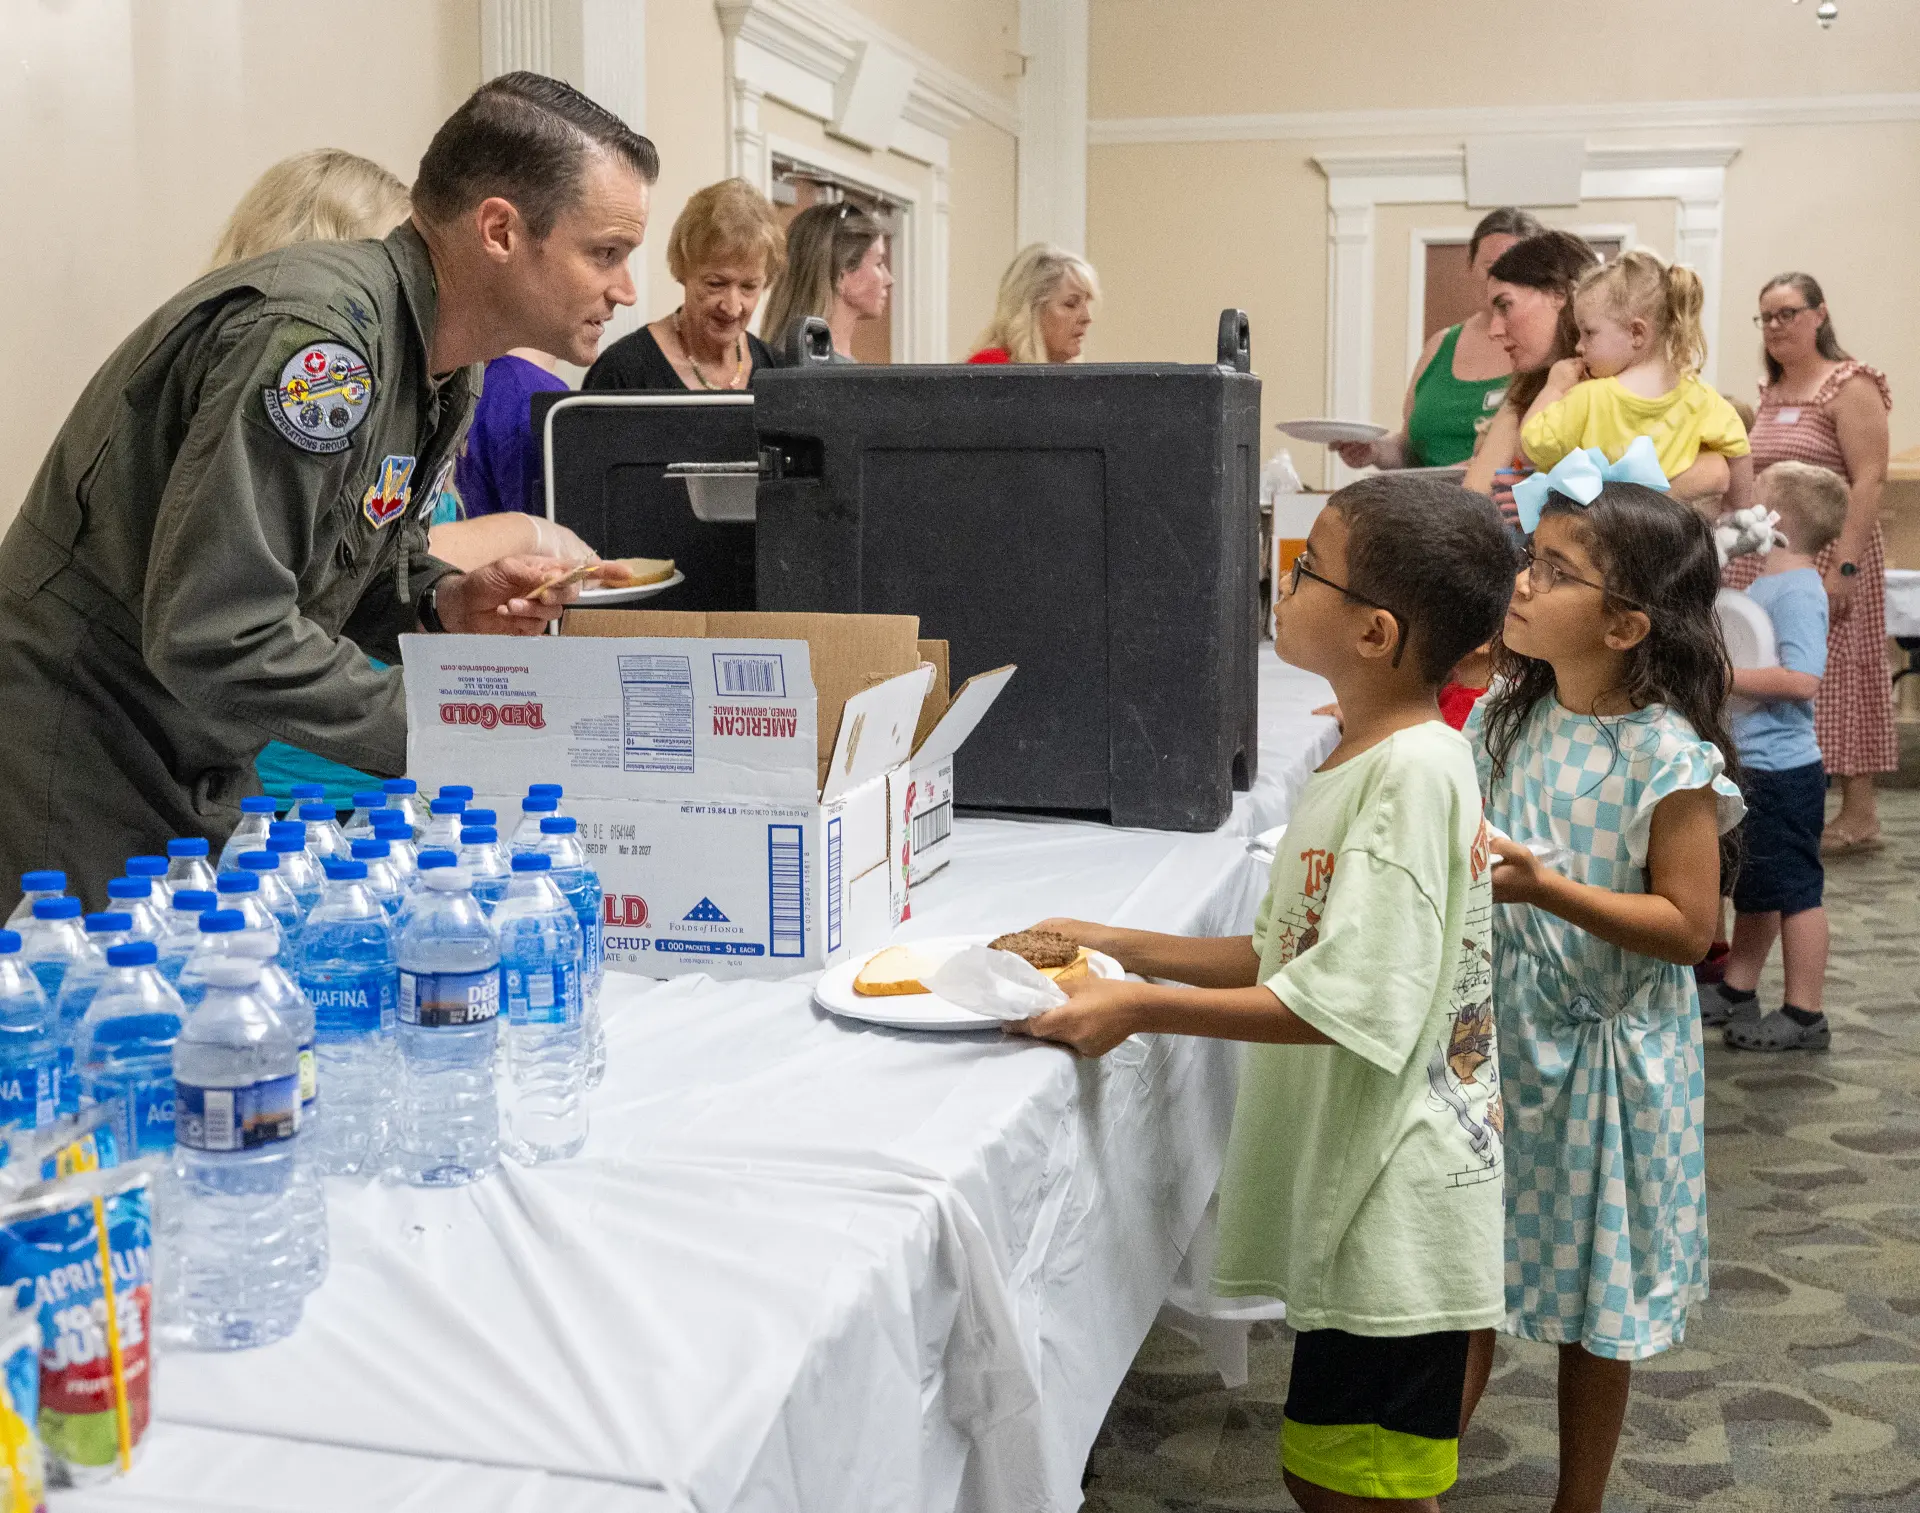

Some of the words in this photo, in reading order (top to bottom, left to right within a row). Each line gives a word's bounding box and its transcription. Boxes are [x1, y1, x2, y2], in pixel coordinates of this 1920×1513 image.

[271, 409, 318, 450] OPERATIONS
[319, 438, 347, 451] GROUP
[440, 703, 499, 730] GOLD
[498, 702, 546, 730] RED
[735, 706, 740, 716] &
[741, 707, 768, 716] GROWN
[768, 707, 797, 718] OWNED,
[713, 716, 797, 738] AMERICAN
[626, 738, 635, 746] 10
[696, 806, 706, 814] WT
[740, 808, 754, 816] PESO
[600, 844, 608, 854] BY
[618, 844, 629, 854] Mar
[638, 846, 652, 856] 2027
[669, 922, 698, 932] FOLDS
[699, 923, 708, 934] of
[710, 924, 744, 934] HONOR
[604, 936, 651, 950] CHUP
[685, 944, 711, 952] PACKETS
[740, 946, 756, 954] EACH
[468, 978, 499, 1003] DEE
[467, 997, 499, 1021] PAR
